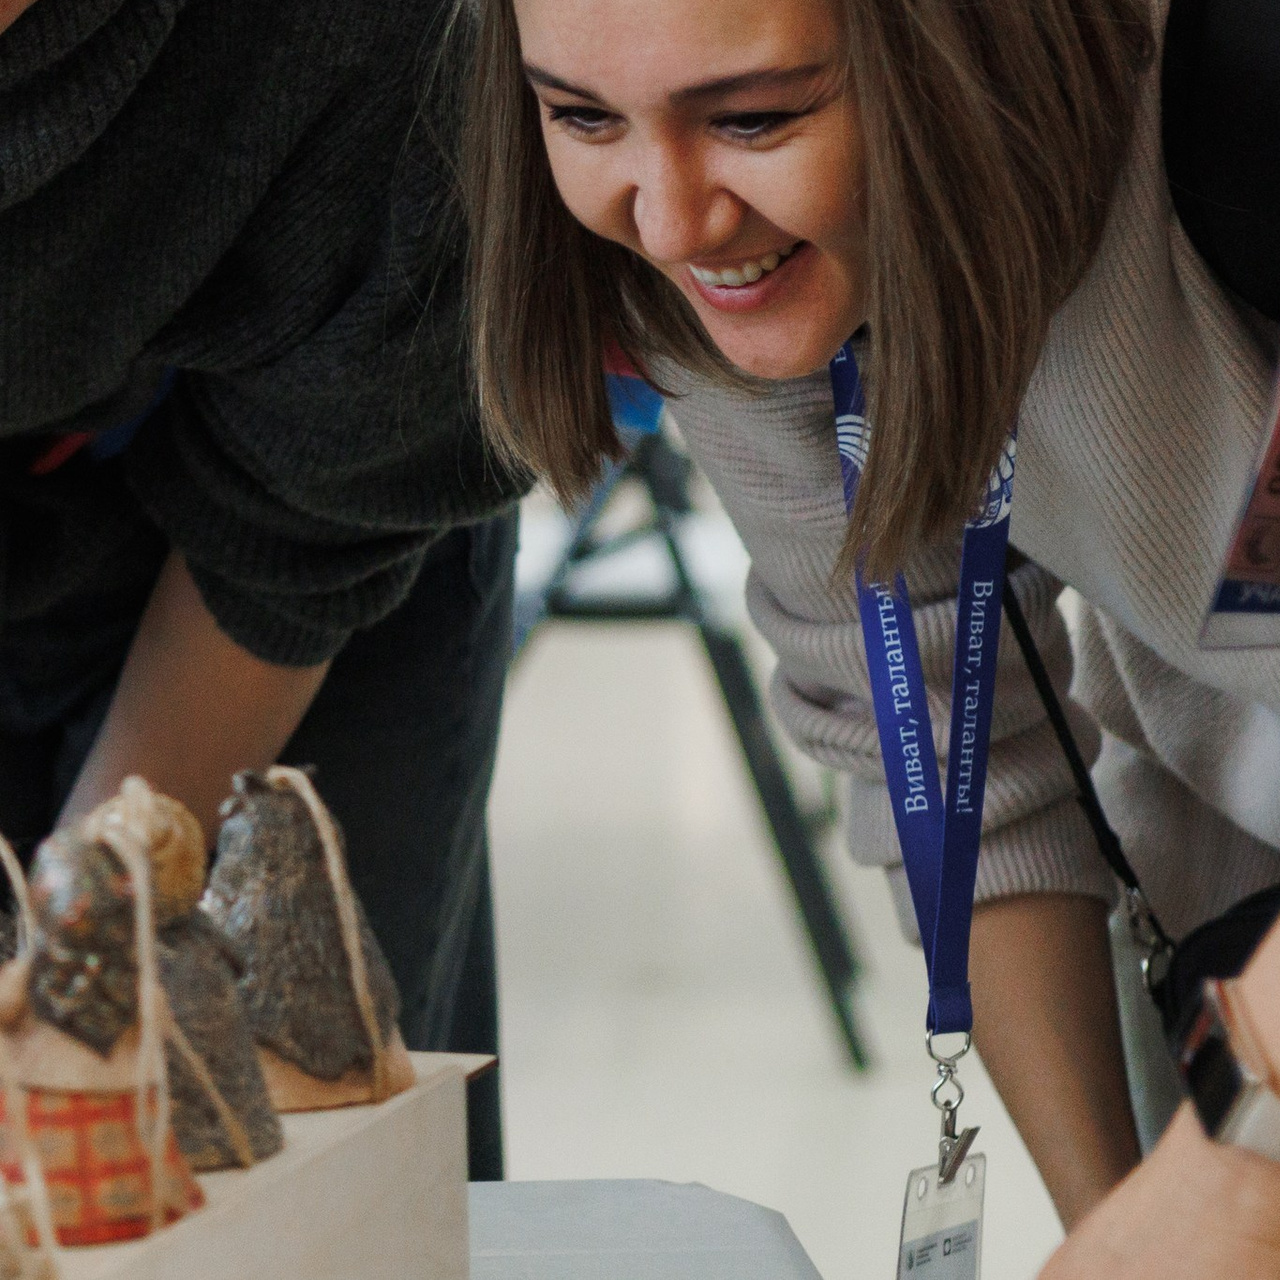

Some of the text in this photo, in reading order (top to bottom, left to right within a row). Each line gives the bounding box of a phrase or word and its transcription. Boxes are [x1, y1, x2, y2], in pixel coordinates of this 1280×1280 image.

[899, 719, 928, 814] Виват,
[956, 580, 994, 813] Виват, таланты!
